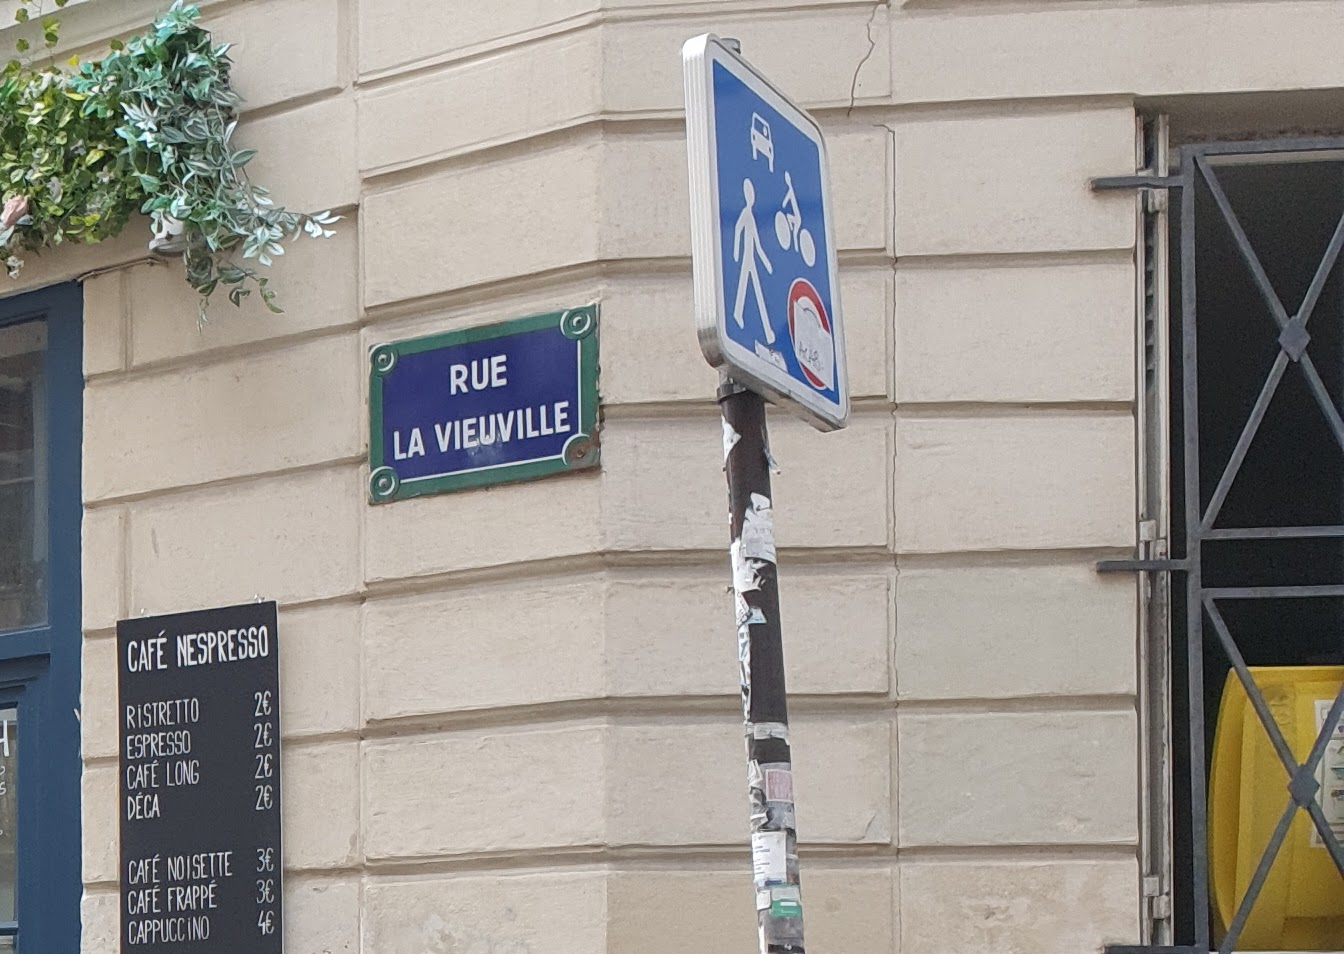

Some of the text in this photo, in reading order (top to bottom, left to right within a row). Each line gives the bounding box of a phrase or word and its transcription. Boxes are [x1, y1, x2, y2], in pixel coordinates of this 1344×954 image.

[449, 354, 508, 396] RUE
[393, 401, 571, 461] LA VIEUVILLE
[127, 625, 269, 673] CAFÉ NESPRESSO
[126, 690, 272, 730] RISTRETTO 2€
[126, 722, 272, 760] ESPRESSO 2€
[126, 754, 273, 790] CAFÉ LONG 2€
[127, 785, 273, 821] DÉCA 2€
[128, 848, 274, 885] CAFÉ NOISETTE 3€
[128, 880, 274, 915] CAFÉ FRAPPÉ 3€
[128, 910, 274, 945] CAPPUCCINO 4€
